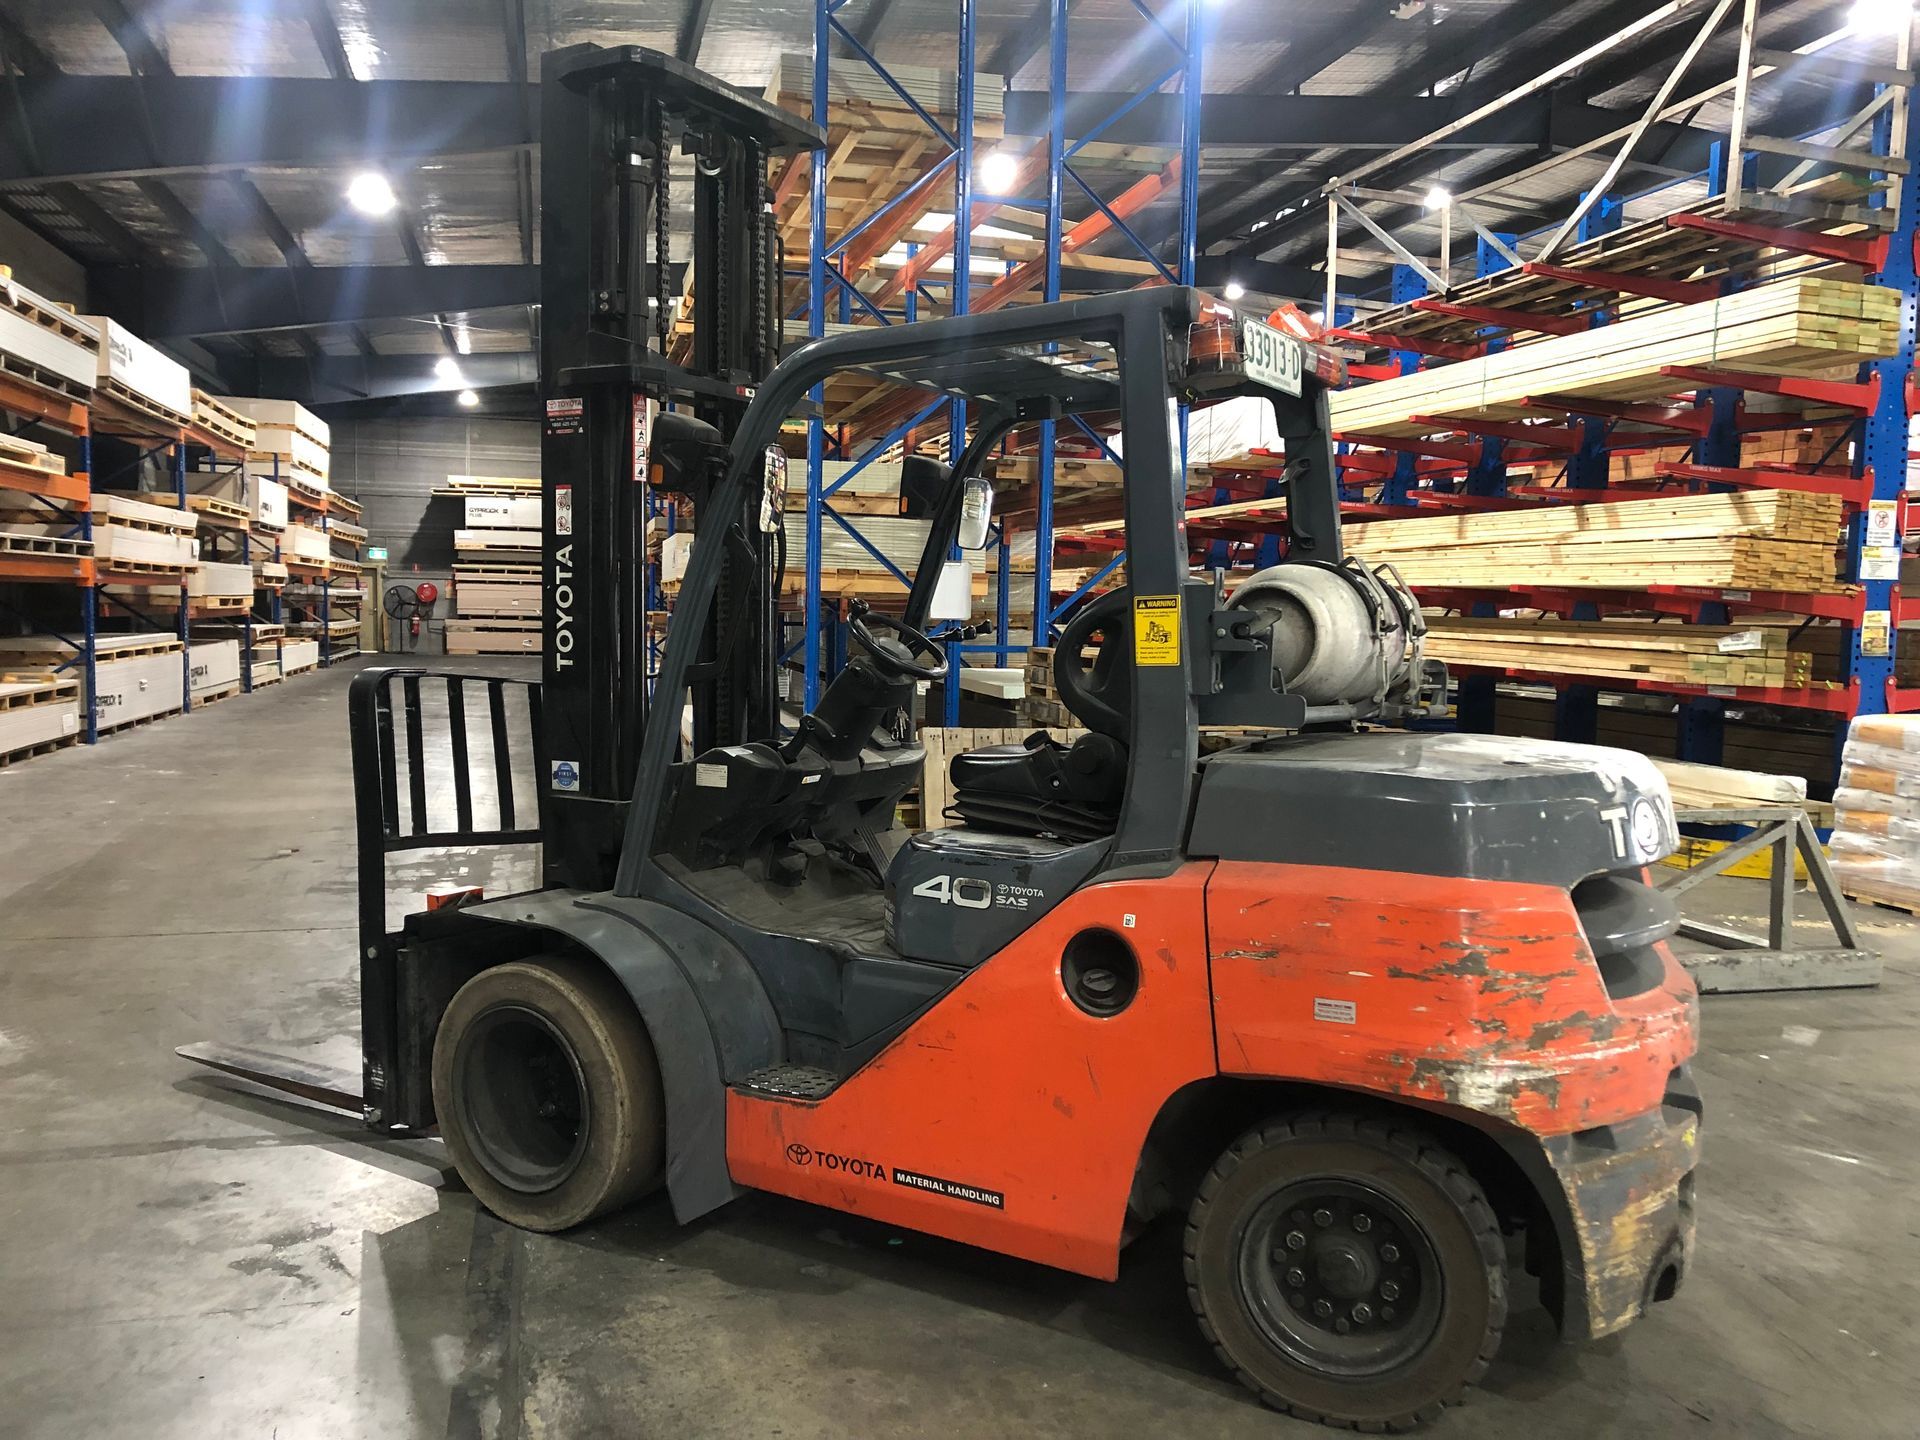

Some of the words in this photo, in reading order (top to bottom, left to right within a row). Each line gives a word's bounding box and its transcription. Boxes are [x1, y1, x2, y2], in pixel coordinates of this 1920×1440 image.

[556, 544, 573, 671] TOYOTA
[1146, 600, 1176, 608] WARNING
[913, 875, 991, 909] 40
[996, 895, 1028, 906] SAS
[1011, 886, 1044, 898] TOYOTA
[815, 1151, 887, 1181] TOYOTA
[896, 1172, 945, 1192] MATERIAL
[947, 1182, 1000, 1205] HANDLING
